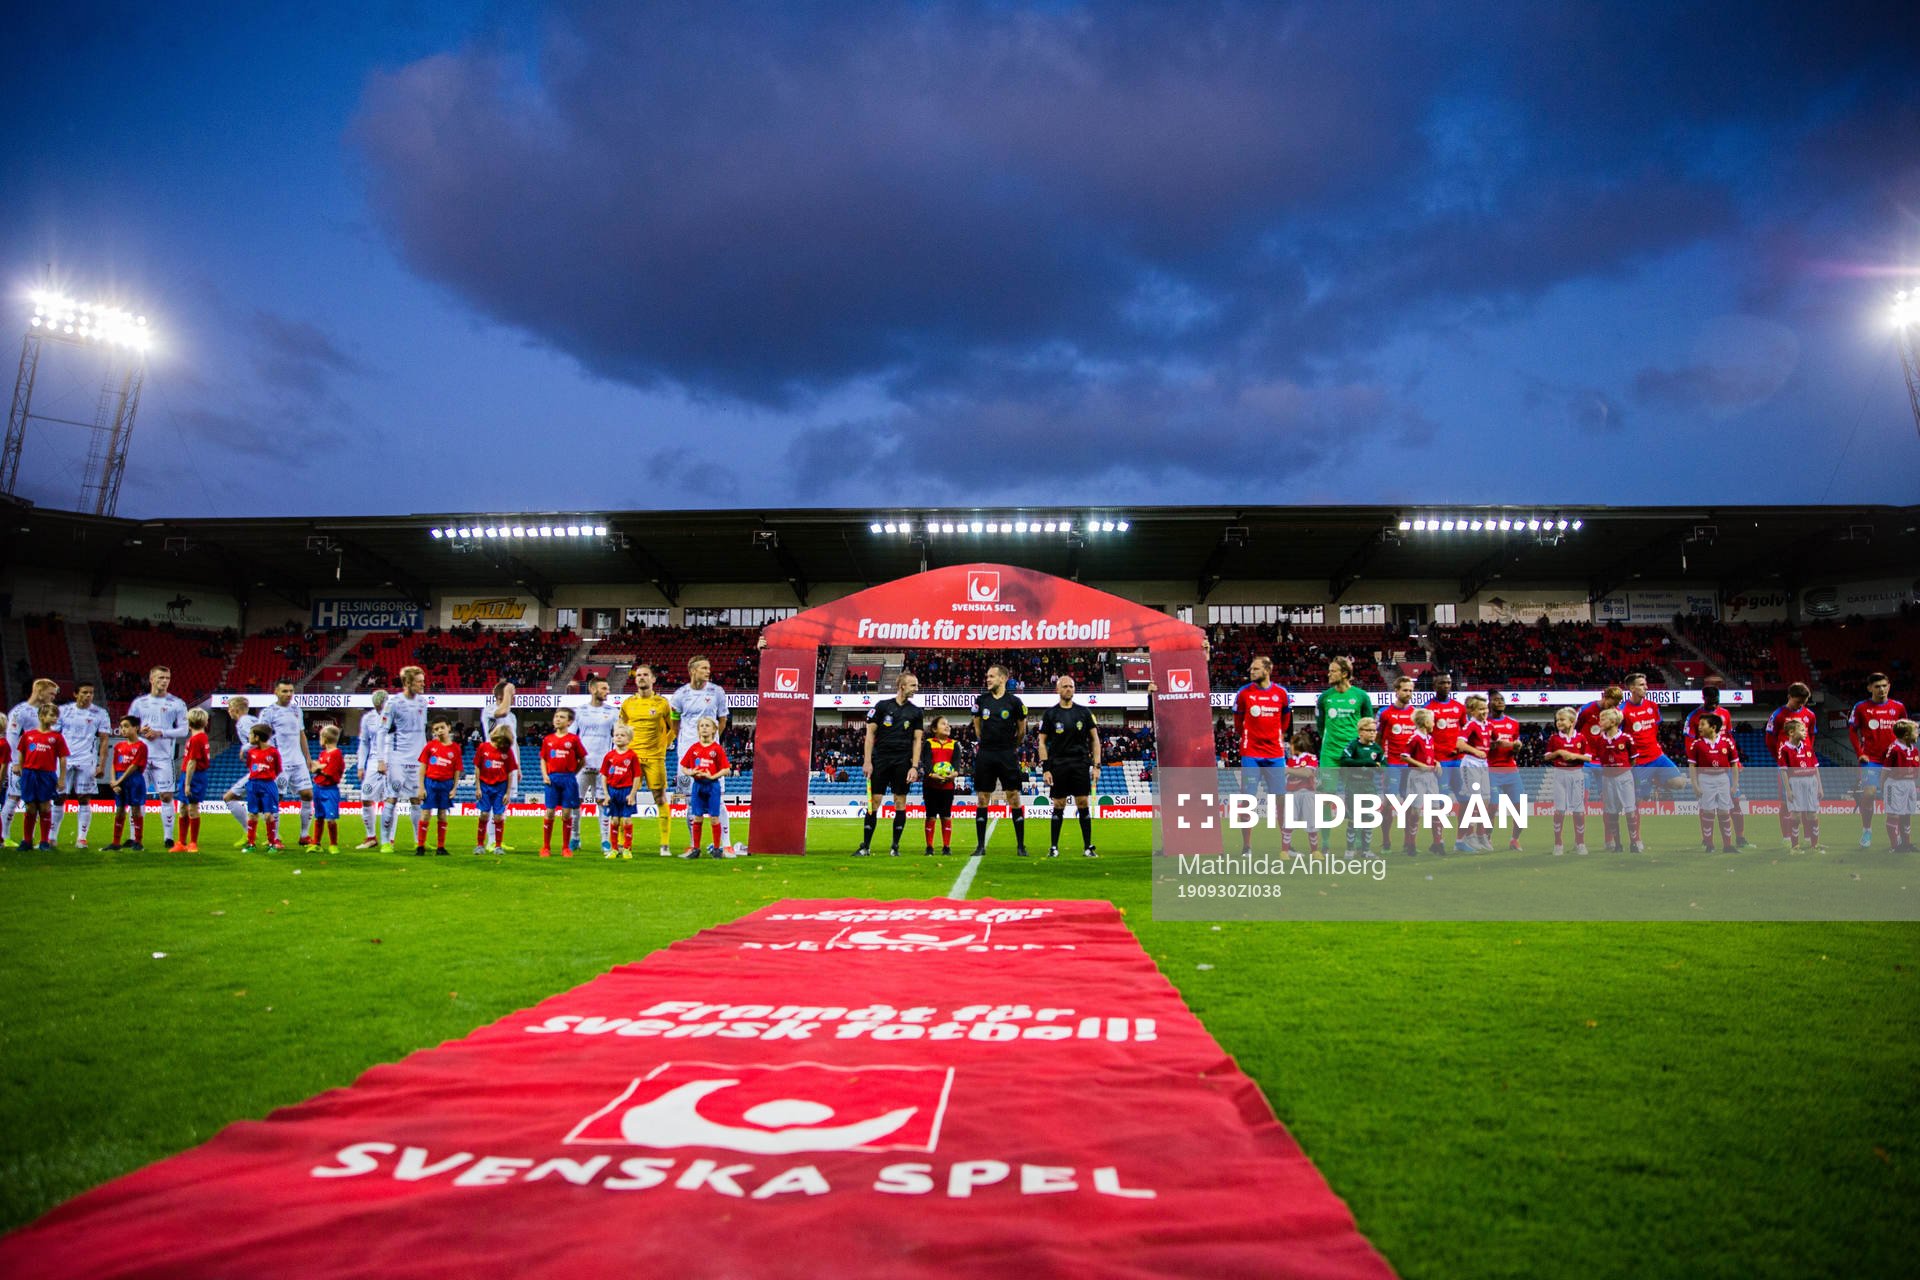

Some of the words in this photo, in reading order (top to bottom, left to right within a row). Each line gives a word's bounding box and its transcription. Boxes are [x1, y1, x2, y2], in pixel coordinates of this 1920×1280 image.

[453, 598, 527, 624] WALLIN
[952, 603, 992, 612] SVENSKA
[994, 604, 1016, 612] SPEL
[317, 601, 419, 628] HELSINGBORGS
[340, 612, 419, 628] BYGGPLÅT
[858, 618, 931, 640] Framåt
[933, 619, 965, 641] för
[966, 619, 1033, 641] svensk
[1037, 619, 1111, 641] fotboll!
[294, 695, 341, 706] SINGBORGS
[344, 695, 352, 706] IF
[554, 695, 563, 707] IF
[925, 694, 976, 706] HELSINGBO
[1225, 694, 1233, 705] IF
[1672, 691, 1681, 702] IF
[1115, 796, 1137, 805] Solid
[1103, 809, 1152, 818] Fotbollens
[638, 1001, 938, 1021] Framåt
[952, 1004, 1076, 1022] för
[525, 1016, 821, 1041] svensk
[834, 1017, 1158, 1043] fotboll!
[310, 1142, 831, 1199] SVENSKA
[874, 1161, 1157, 1198] SPEL
